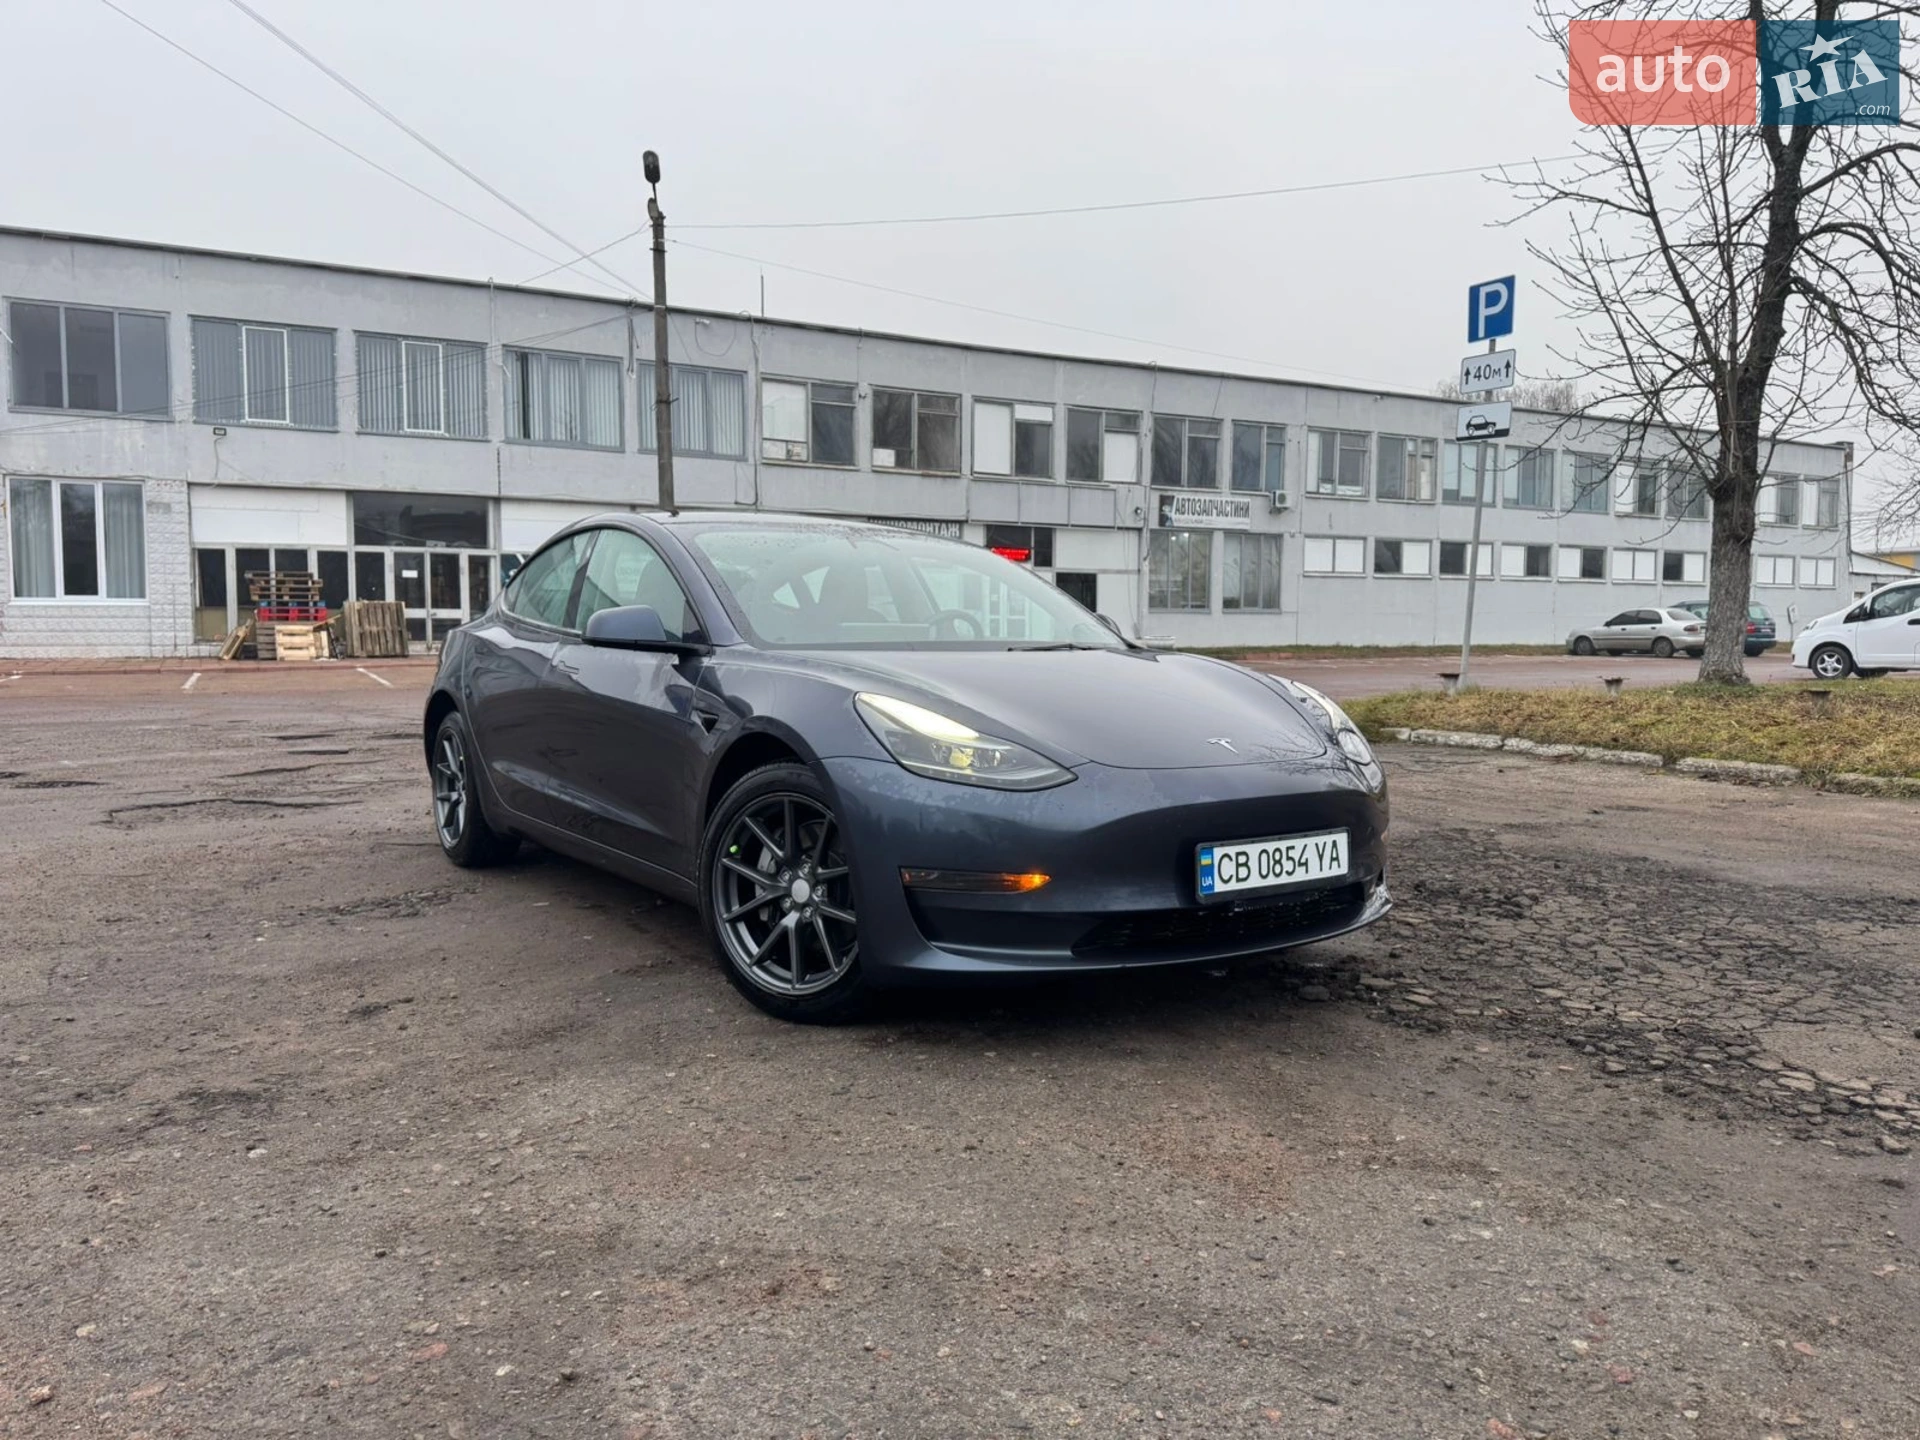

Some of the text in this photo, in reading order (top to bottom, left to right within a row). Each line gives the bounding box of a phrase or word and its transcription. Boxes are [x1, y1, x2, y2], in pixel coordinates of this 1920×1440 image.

[1478, 281, 1508, 338] P
[1174, 497, 1251, 519] АВТОЗАПЧАСТИНИ
[1217, 839, 1341, 884] CB 0854 YA
[1201, 877, 1213, 887] UA
